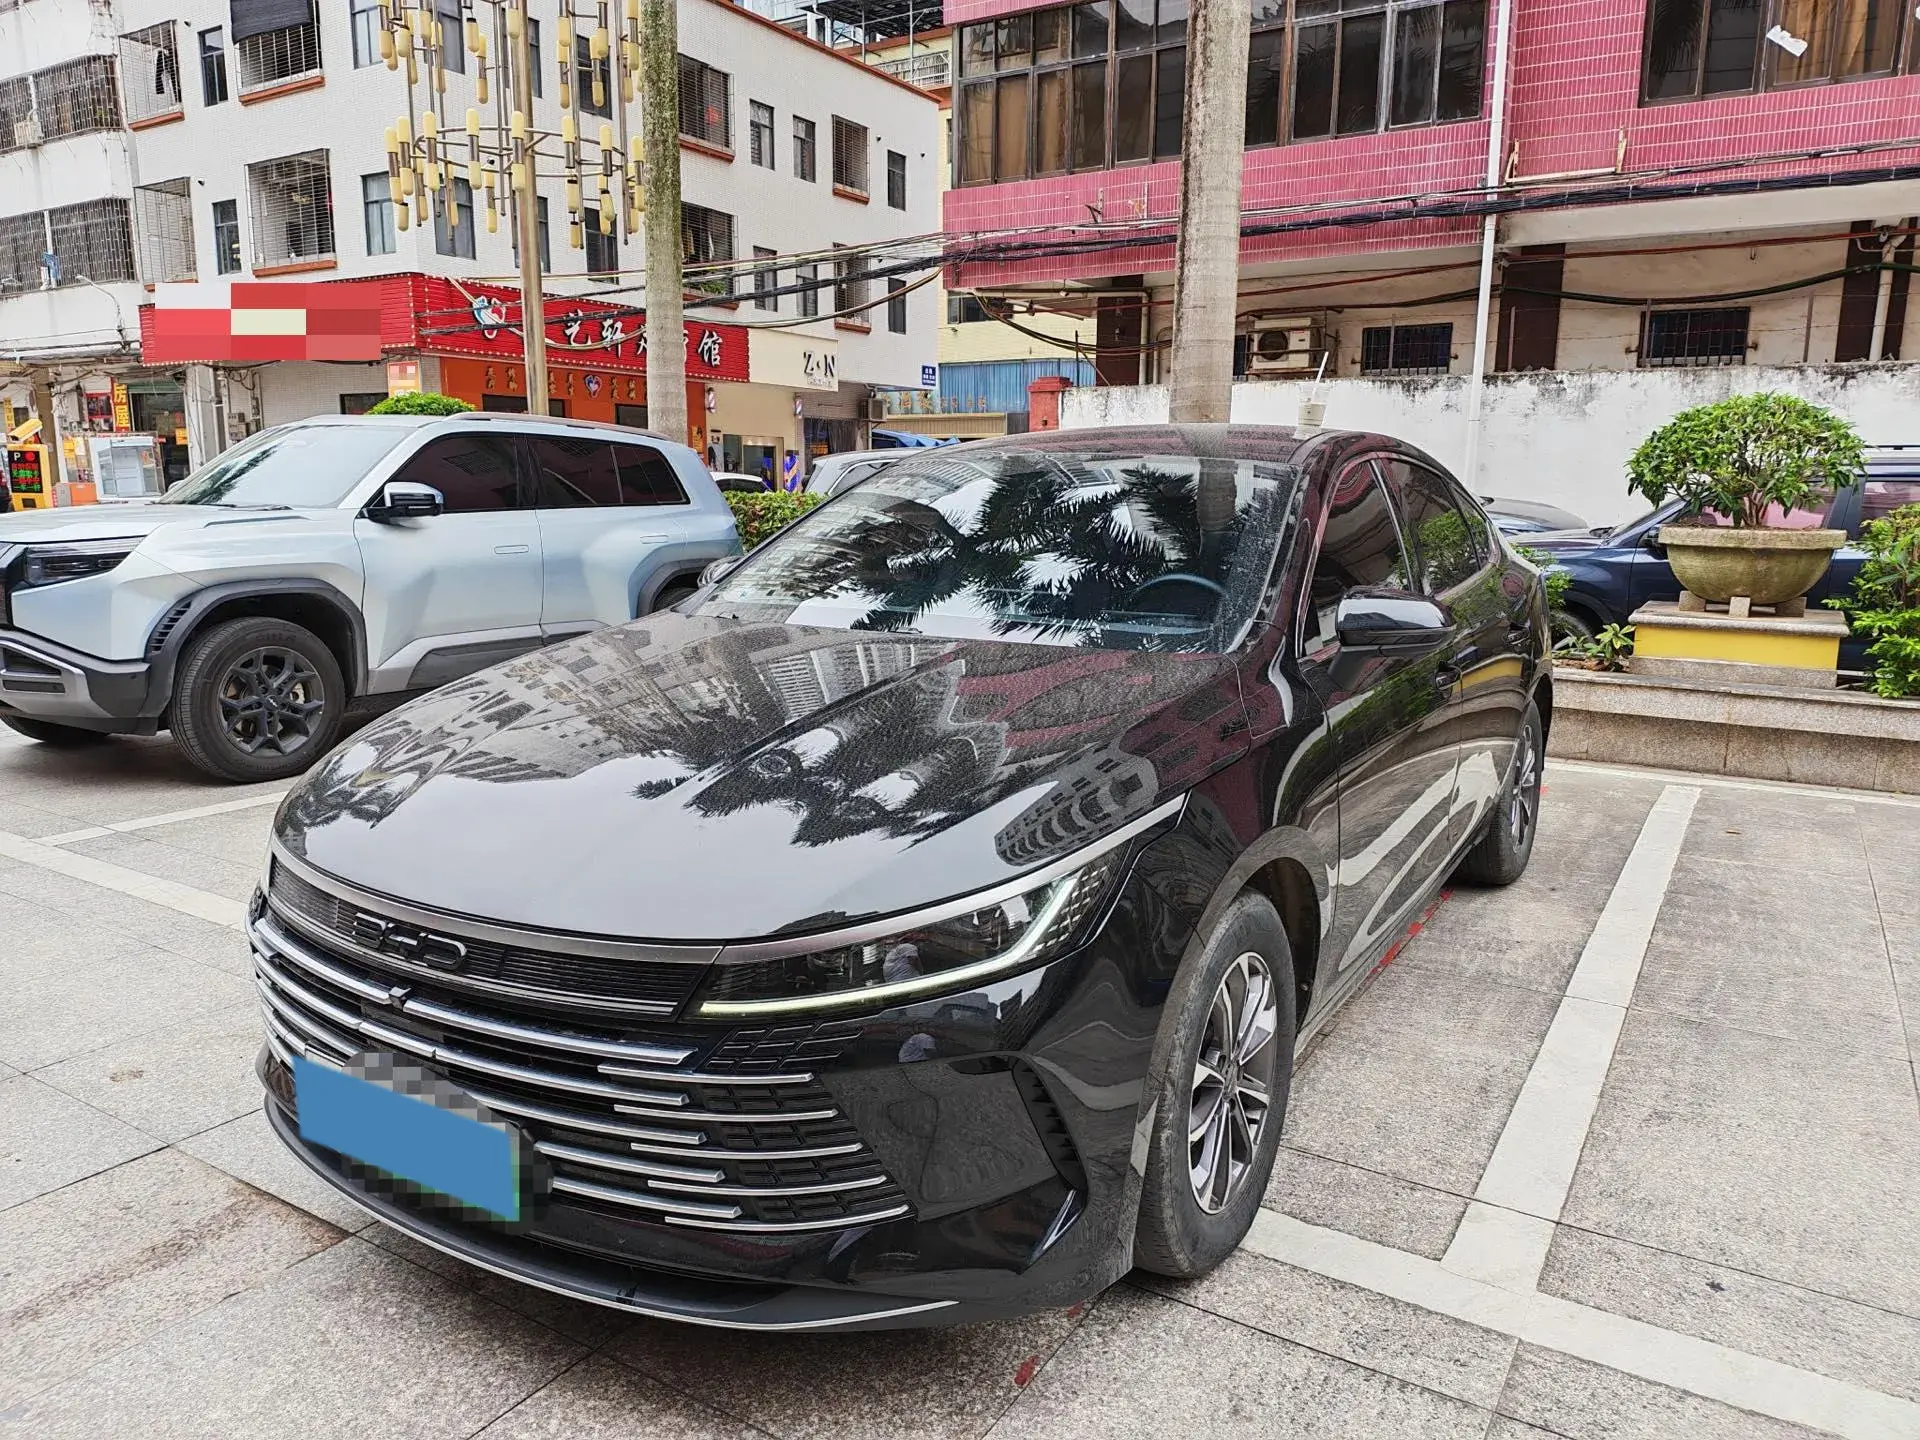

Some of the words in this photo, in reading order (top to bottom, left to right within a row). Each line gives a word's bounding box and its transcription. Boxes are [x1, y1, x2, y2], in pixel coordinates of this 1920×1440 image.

[564, 308, 725, 369] 艺轩馆
[114, 383, 131, 428] 房屋
[14, 452, 21, 461] P
[352, 912, 467, 970] BYD
